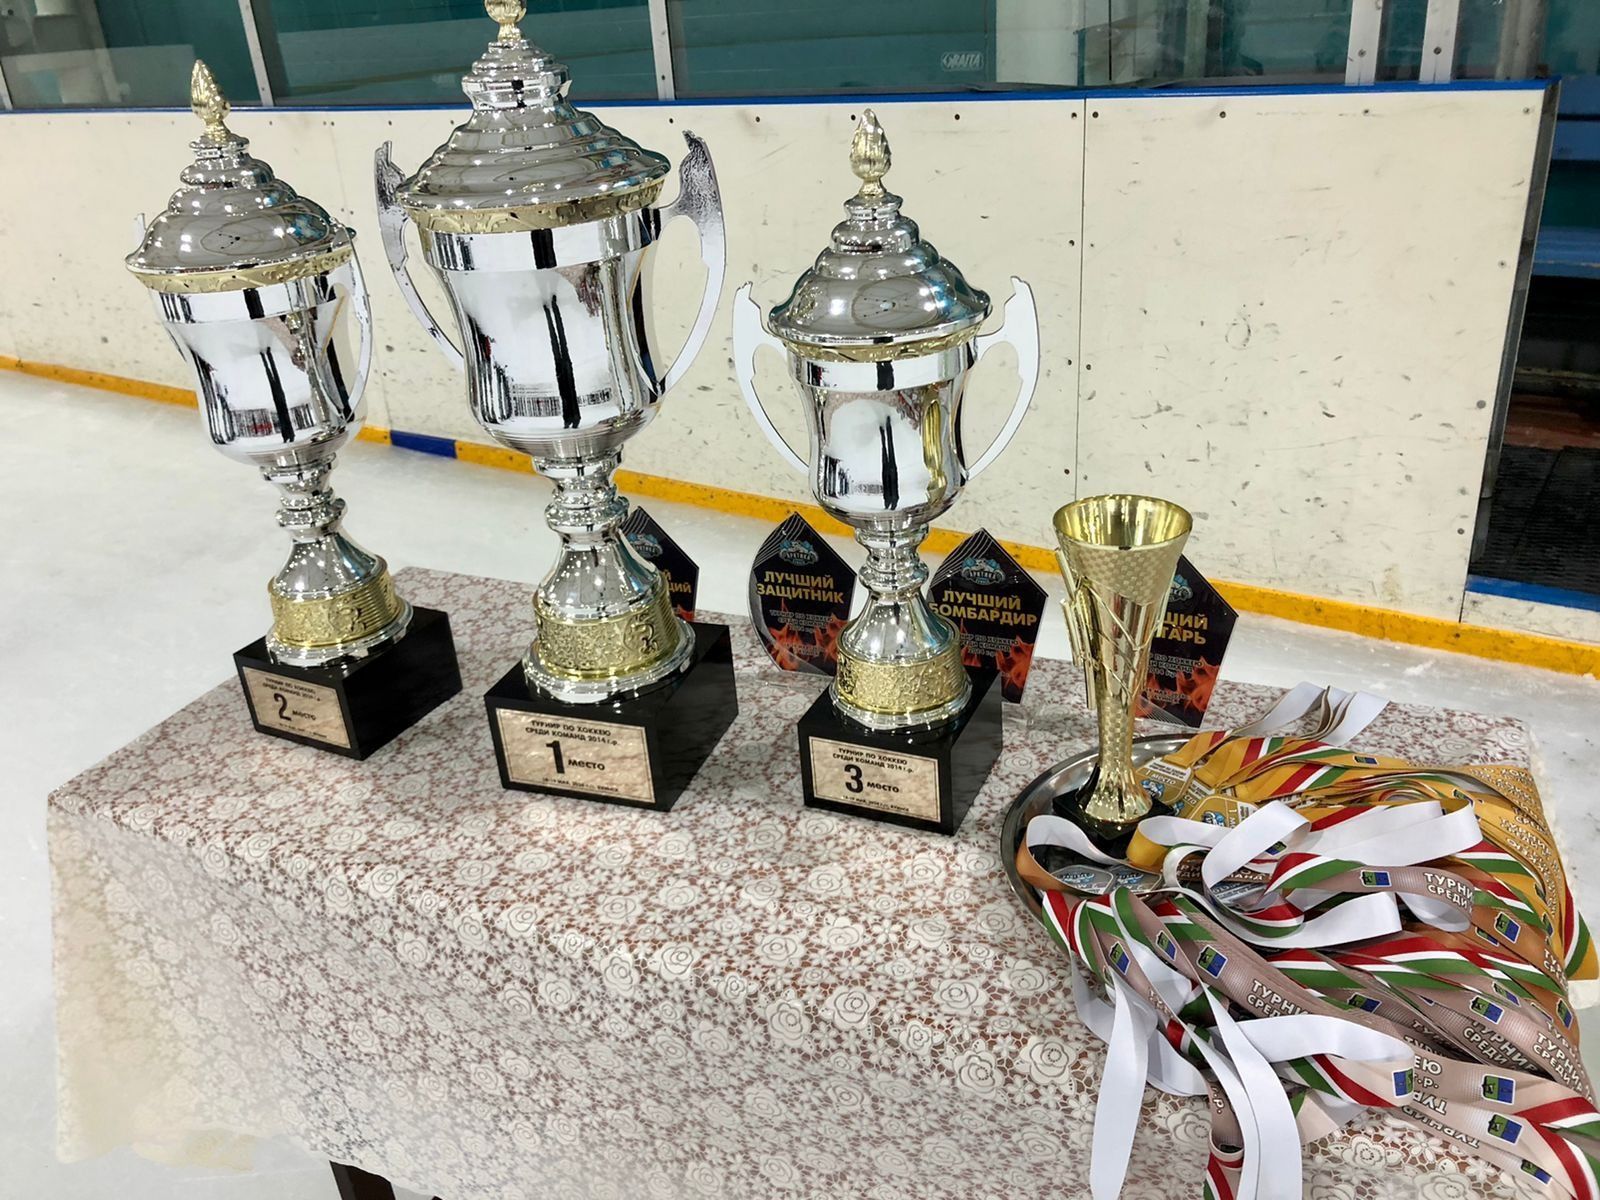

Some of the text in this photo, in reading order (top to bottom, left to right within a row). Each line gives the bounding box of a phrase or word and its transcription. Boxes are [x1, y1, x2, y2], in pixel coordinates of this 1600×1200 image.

[763, 571, 834, 589] ЛУЧШИЙ
[756, 583, 845, 604] ЗАЩИТНИК
[942, 590, 1021, 611] ЛУЧШИЙ
[928, 602, 1038, 626] БОМБАРДИР
[1164, 612, 1208, 630] ШИЙ
[1158, 627, 1206, 645] ТАРЬ
[273, 692, 292, 721] 2
[525, 726, 550, 736] СРЕДИ
[551, 730, 586, 741] КОМАНД
[531, 720, 611, 737] ТУРНИР ПО ХОККЕЮ
[545, 740, 565, 774] 1
[832, 753, 854, 761] СРЕДИ
[855, 757, 885, 768] КОМАНД
[838, 747, 908, 765] ТУРНИР ПО ХОККЕЮ
[844, 763, 864, 794] 3
[1423, 872, 1473, 899] ТУРНИ
[1427, 884, 1467, 909] СРЕДИ
[1247, 994, 1280, 1017] СРЕД
[1463, 1027, 1508, 1064] СРЕДИ
[1533, 1044, 1571, 1086] СРЕДИ
[1537, 1032, 1583, 1093] ТУРНИР
[1413, 1090, 1447, 1116] ТУР
[1402, 1105, 1480, 1149] ТУРНИР
